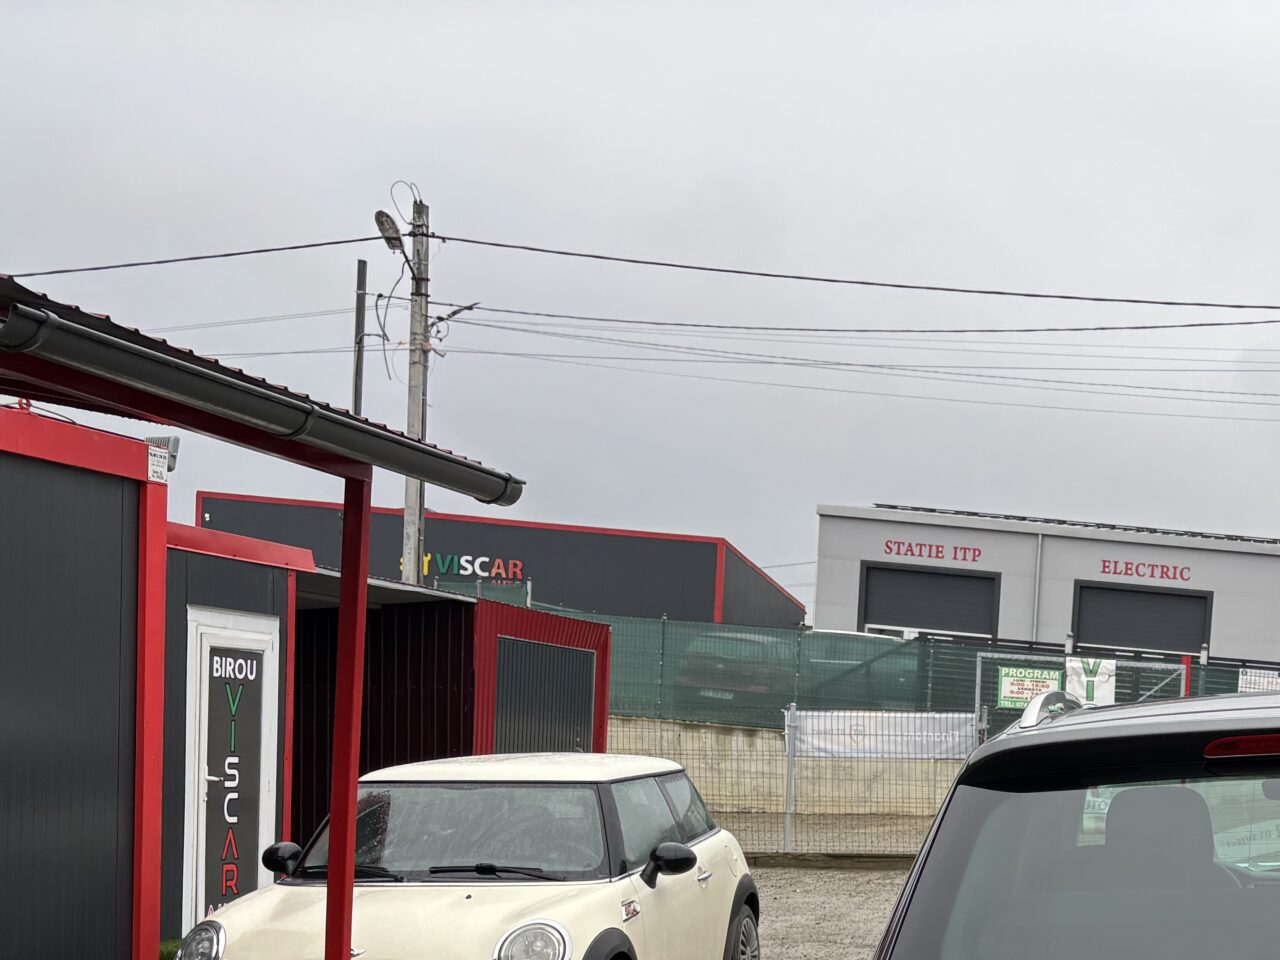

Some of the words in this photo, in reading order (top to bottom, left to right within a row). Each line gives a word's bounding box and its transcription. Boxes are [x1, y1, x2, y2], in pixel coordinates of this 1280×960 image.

[884, 540, 945, 559] STATIE
[952, 546, 982, 562] ITP
[435, 553, 523, 580] VISCAR
[1100, 559, 1191, 581] ELECTRIC
[213, 656, 257, 681] BIROU
[1001, 667, 1059, 680] PROGRAM
[221, 682, 244, 896] VISCAR
